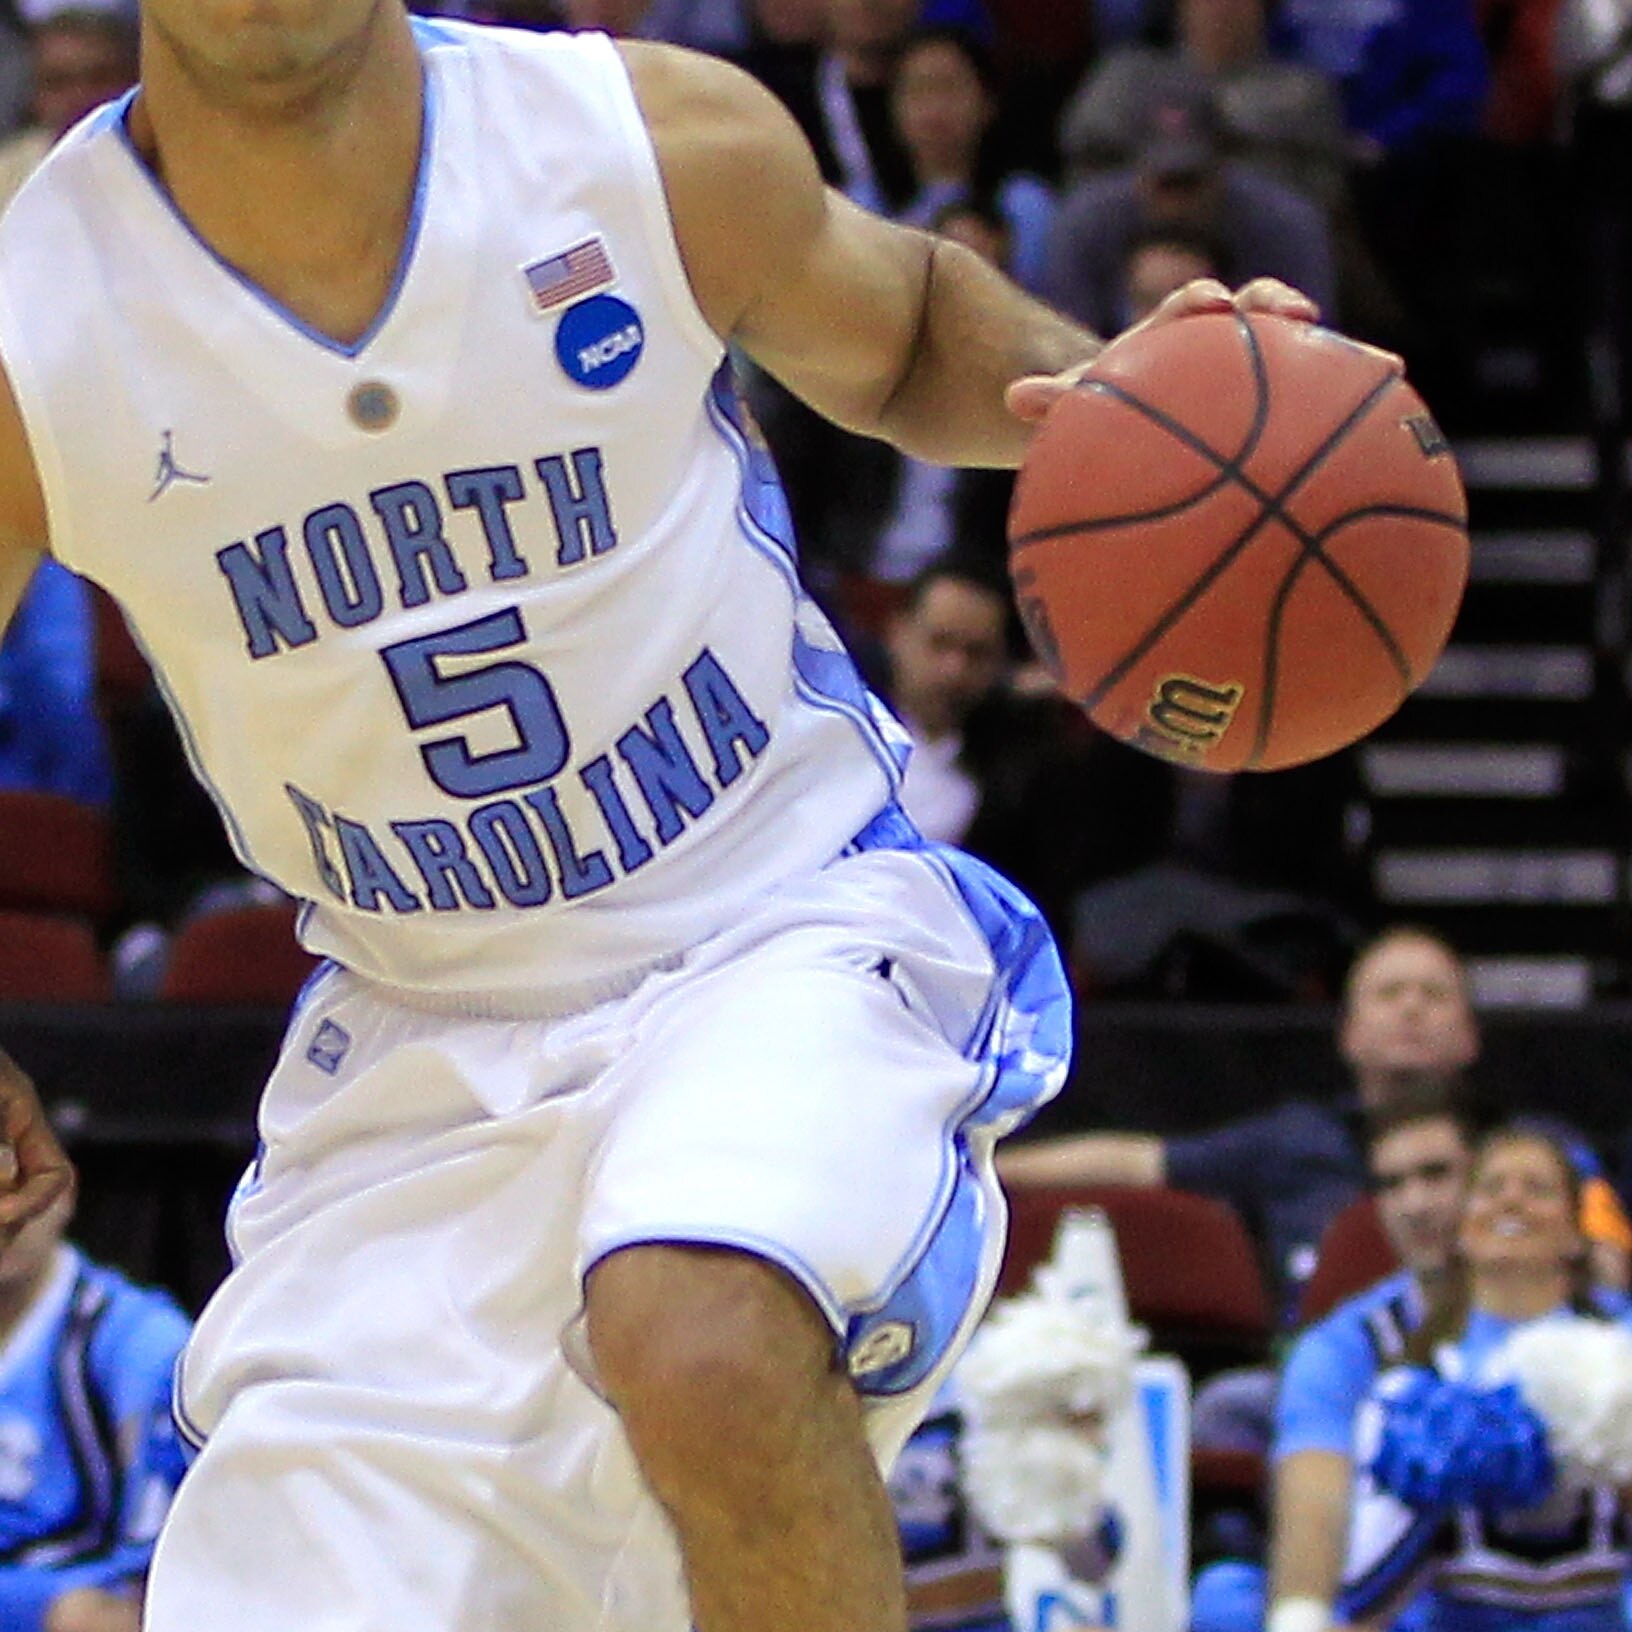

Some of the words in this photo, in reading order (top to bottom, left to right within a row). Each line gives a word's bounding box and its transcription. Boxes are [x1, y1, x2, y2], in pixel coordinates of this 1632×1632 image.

[577, 325, 641, 374] NCAA
[217, 448, 616, 658] NORTH
[286, 650, 769, 912] CAROLINA
[380, 608, 569, 797] 5
